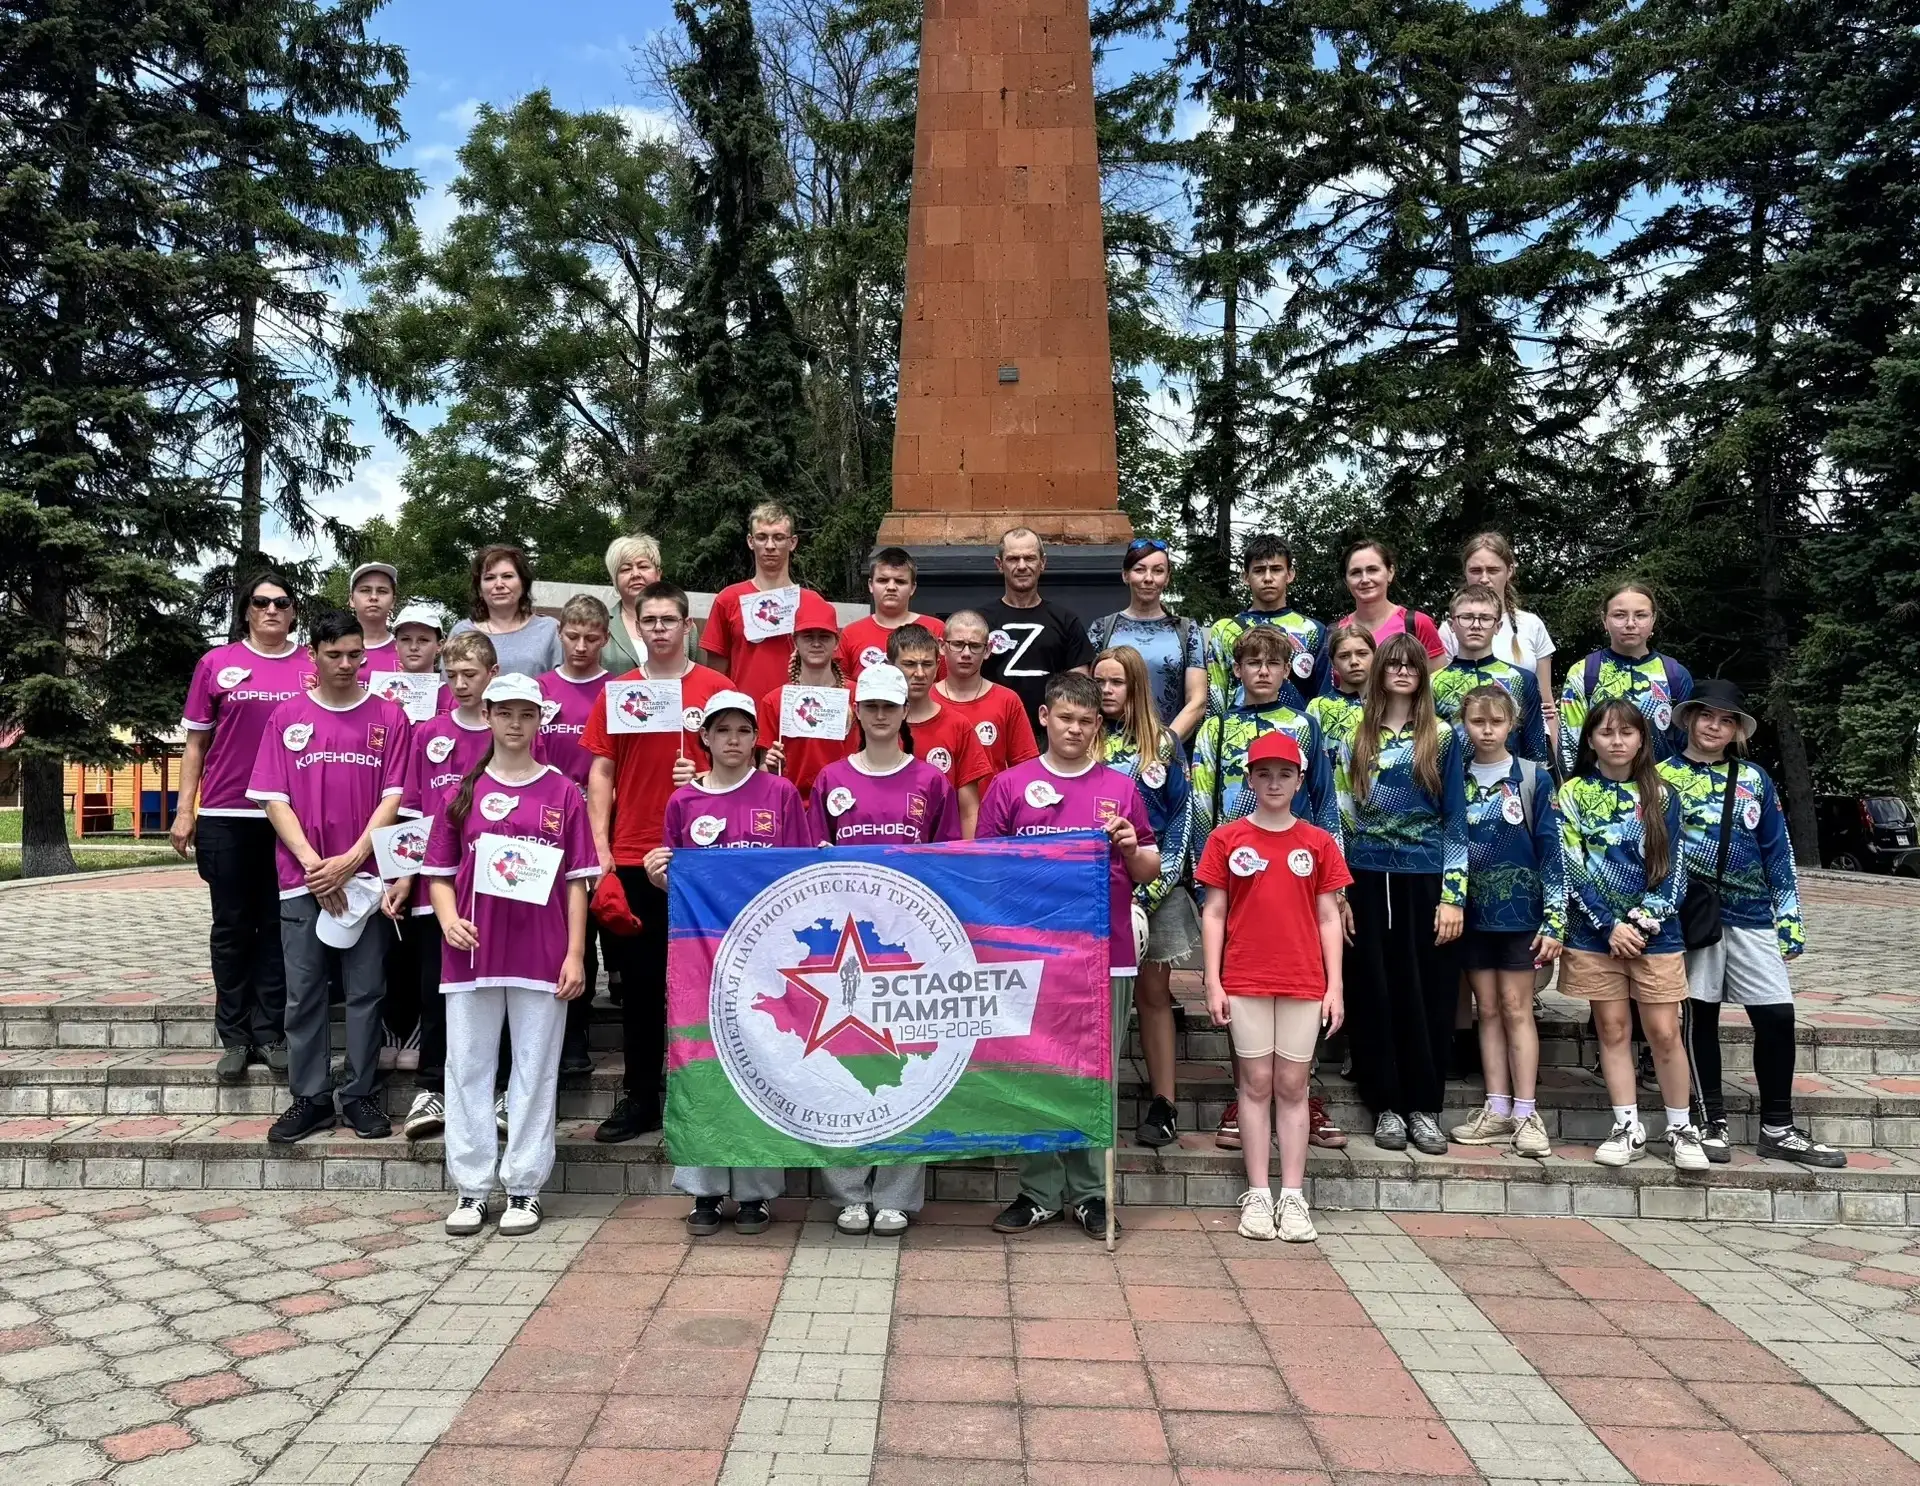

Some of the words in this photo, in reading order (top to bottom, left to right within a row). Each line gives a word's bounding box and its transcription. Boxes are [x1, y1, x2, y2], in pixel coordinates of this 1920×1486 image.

[1001, 622, 1051, 677] Z
[227, 690, 300, 702] КОРЕНО
[295, 751, 382, 770] КОРЕНОВСК
[732, 879, 882, 972] ПАТРИОТИЧЕСКАЯ
[887, 887, 953, 954] ТУРИАДА
[871, 968, 1028, 998] ЭСТАФЕТА
[871, 995, 998, 1023] ПАМЯТИ
[898, 1019, 993, 1041] 1945-2026
[724, 976, 798, 1116] ВЕЛОСИПЕДНАЯ
[801, 1103, 892, 1128] КРАЕВАЯ
